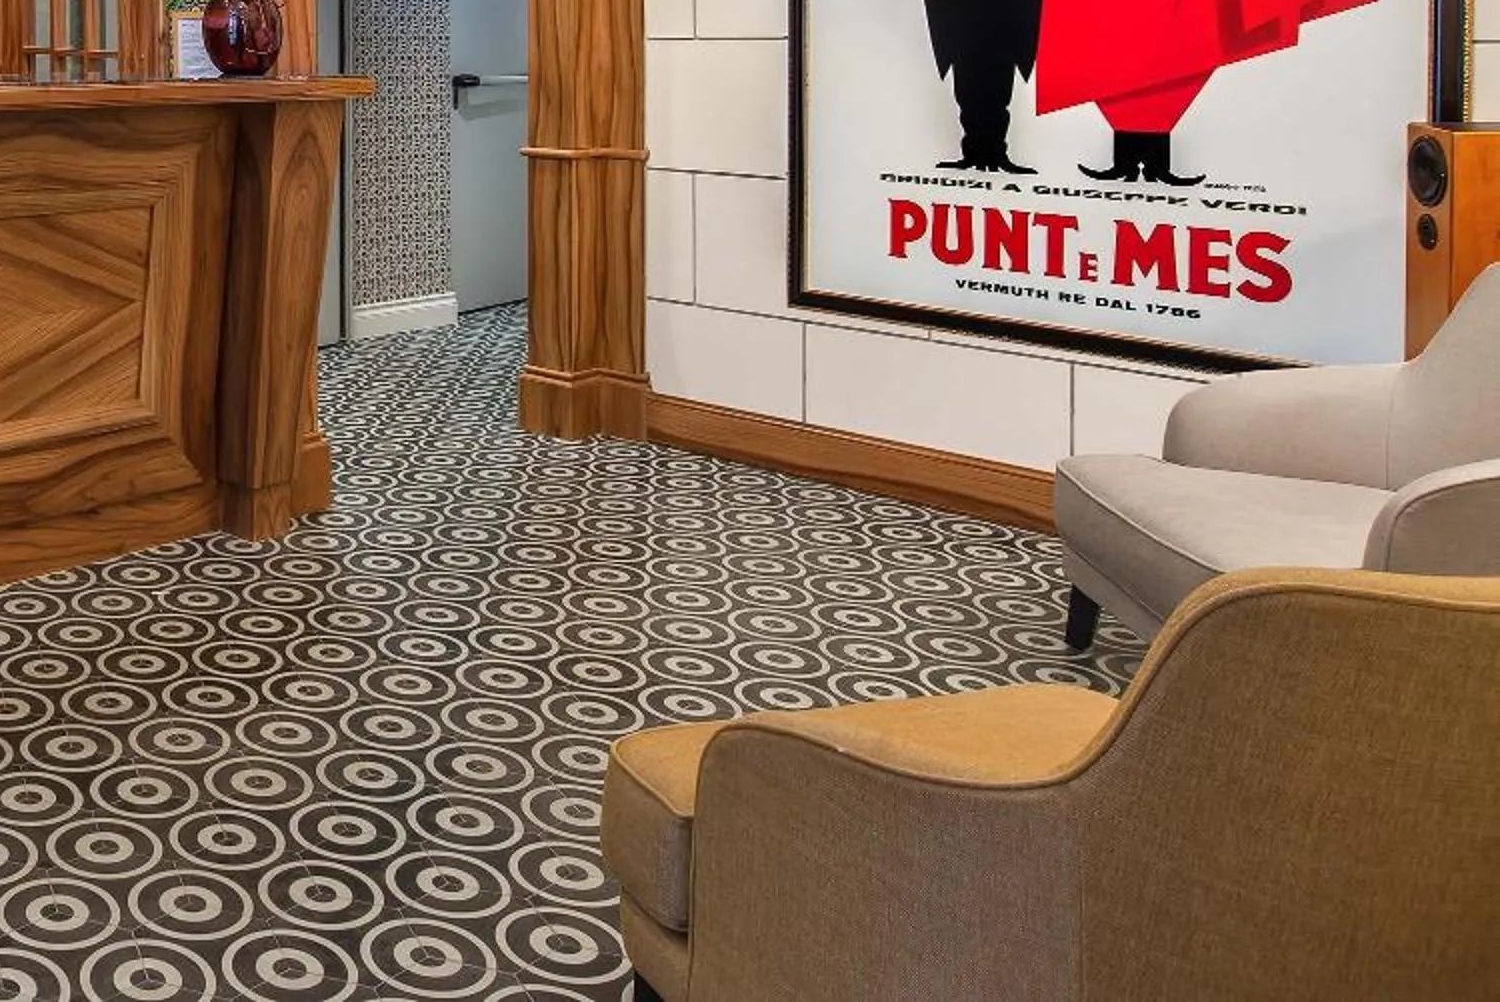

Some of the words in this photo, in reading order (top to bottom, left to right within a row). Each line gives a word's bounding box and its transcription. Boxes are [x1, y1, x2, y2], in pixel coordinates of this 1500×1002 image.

[1002, 183, 1022, 193] A
[1200, 199, 1308, 215] VERDI
[887, 198, 1080, 279] PUNT
[1111, 219, 1294, 303] MES
[955, 279, 1050, 301] VERMUTH
[1058, 291, 1087, 305] RE
[1095, 297, 1138, 312] DAL
[1146, 303, 1202, 319] 1786
